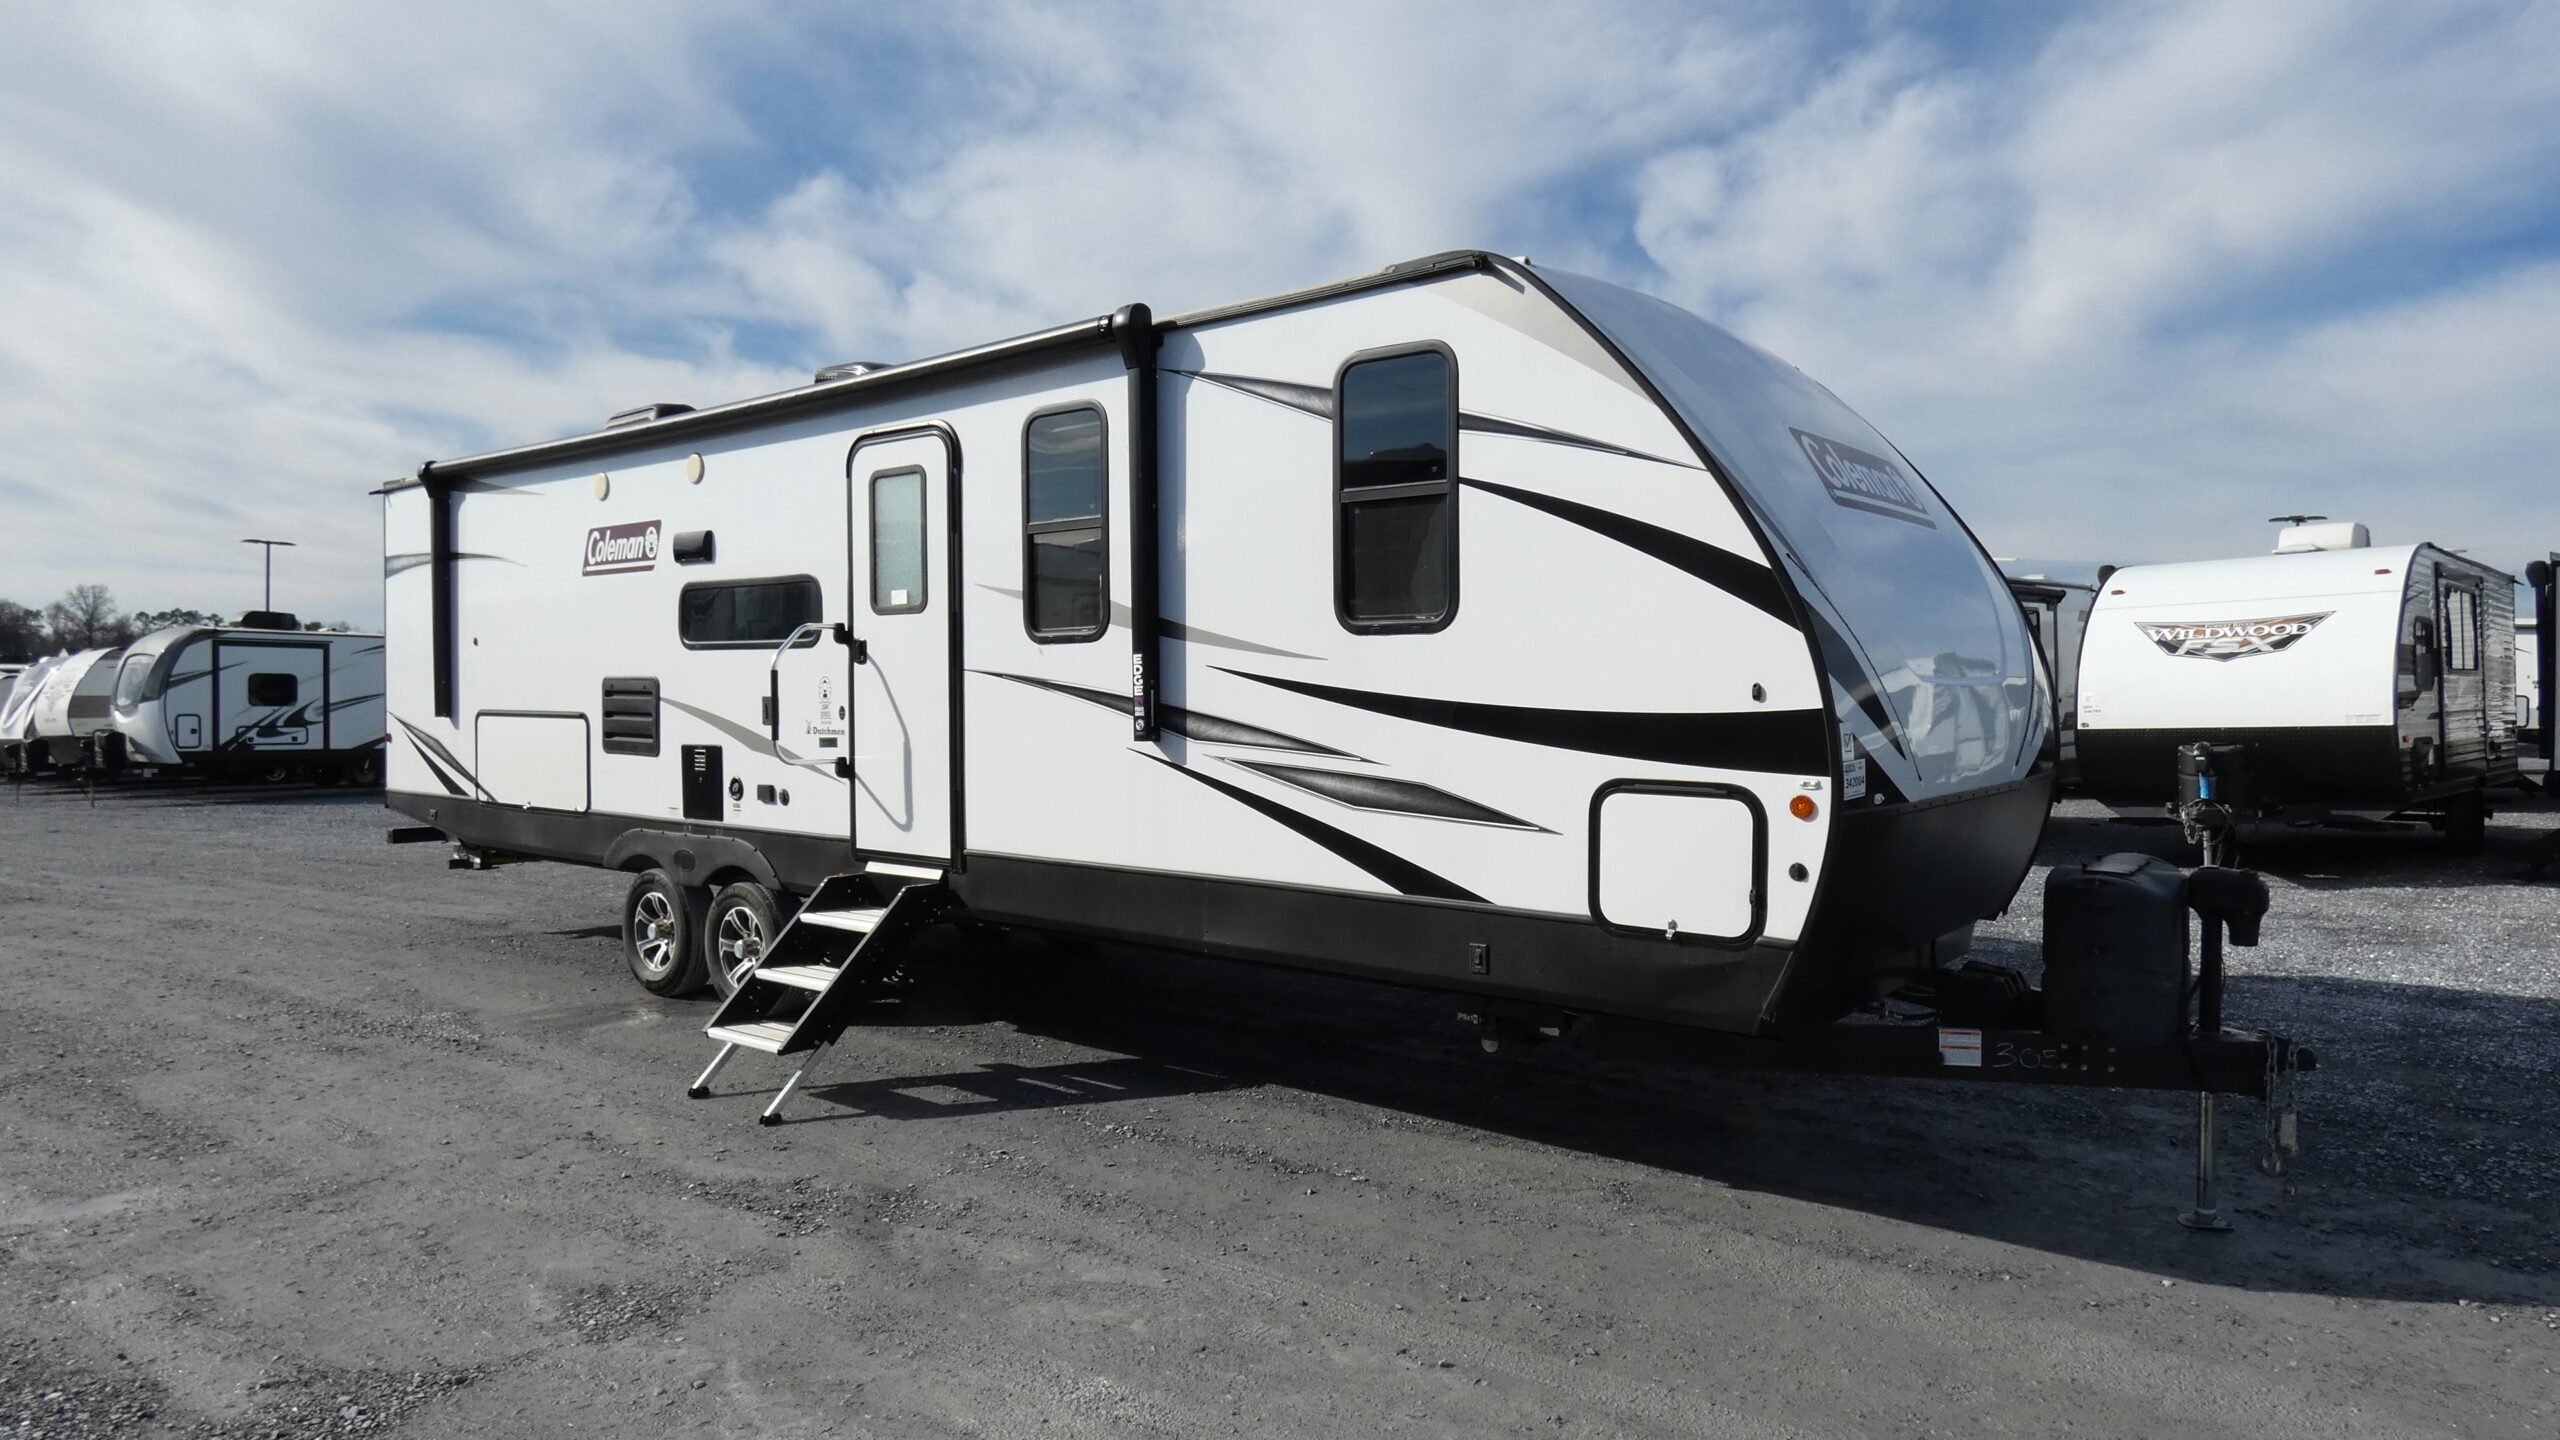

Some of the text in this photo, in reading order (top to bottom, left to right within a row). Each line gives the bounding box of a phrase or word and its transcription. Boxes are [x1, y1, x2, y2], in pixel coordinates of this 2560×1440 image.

[1801, 434, 1907, 504] Coleman
[587, 529, 645, 565] Coleman
[2147, 623, 2312, 642] WILDWOOD
[2174, 636, 2288, 655] FSX
[1133, 653, 1144, 696] EDGE
[812, 727, 845, 736] Dutchmen
